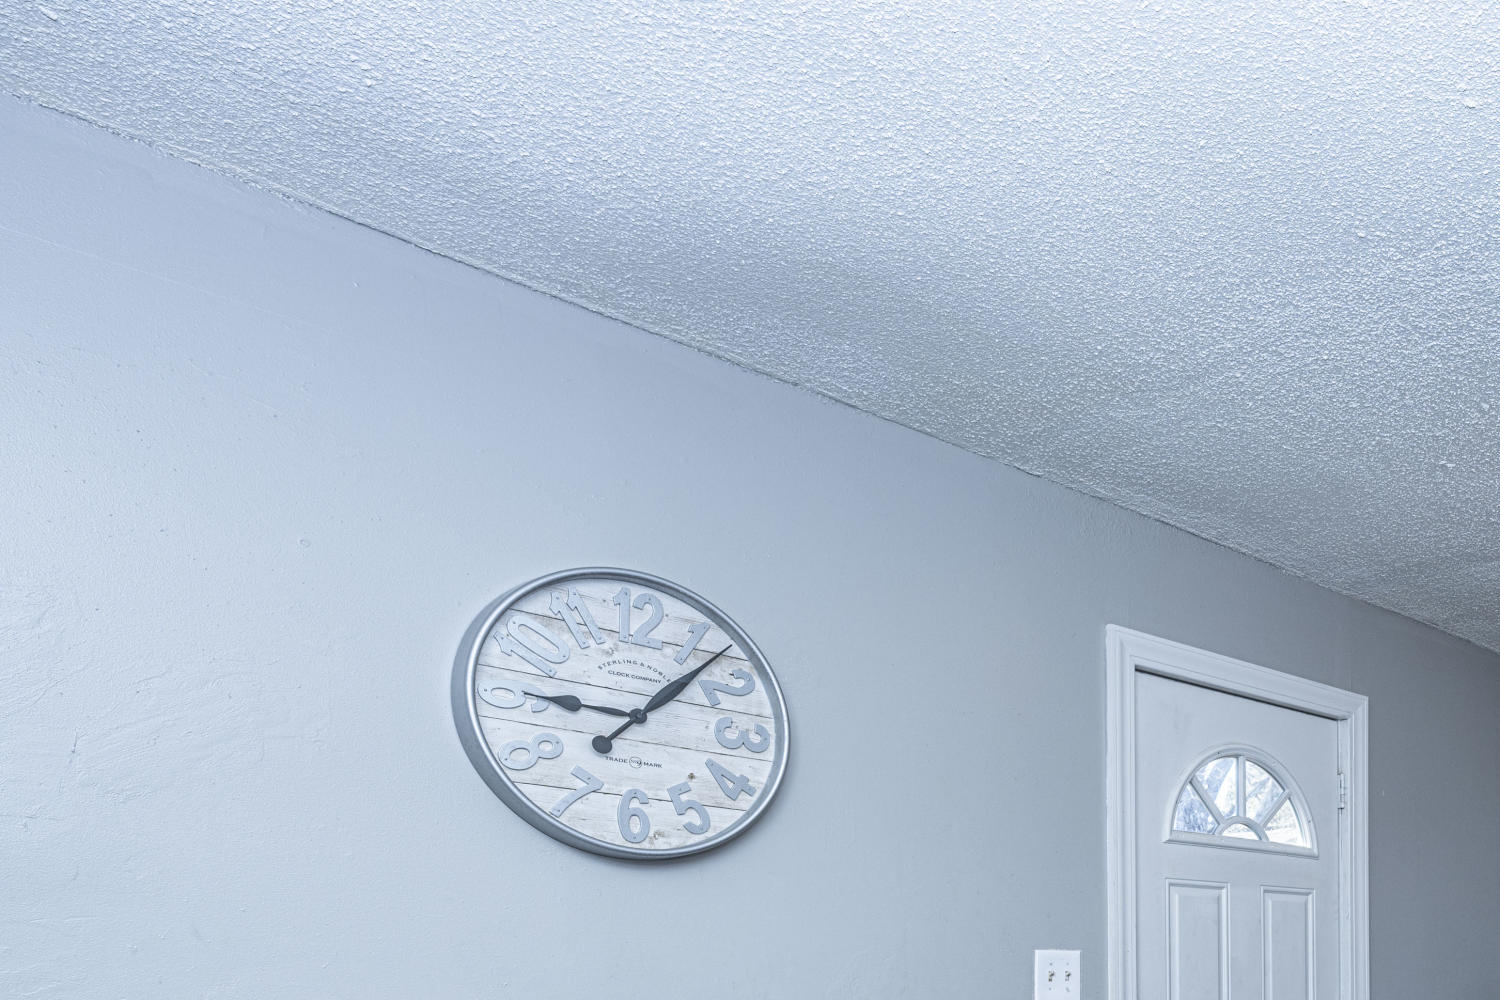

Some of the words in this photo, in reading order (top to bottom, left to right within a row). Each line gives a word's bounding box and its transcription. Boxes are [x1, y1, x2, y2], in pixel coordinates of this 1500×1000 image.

[549, 586, 606, 650] 11
[612, 586, 663, 650] 12
[493, 615, 570, 677] 10
[673, 621, 711, 665] 1
[598, 659, 638, 669] STERLING
[647, 665, 672, 683] NOBLE
[608, 670, 631, 678] CLOCK
[631, 674, 662, 684] COMPANY
[697, 668, 756, 706] 2
[477, 679, 550, 714] 9
[498, 732, 564, 772] 8
[714, 716, 771, 754] 3
[605, 756, 628, 764] TRADE
[705, 757, 756, 802] 4
[548, 765, 605, 817] 7
[667, 782, 711, 835] 5
[617, 788, 650, 843] 6
